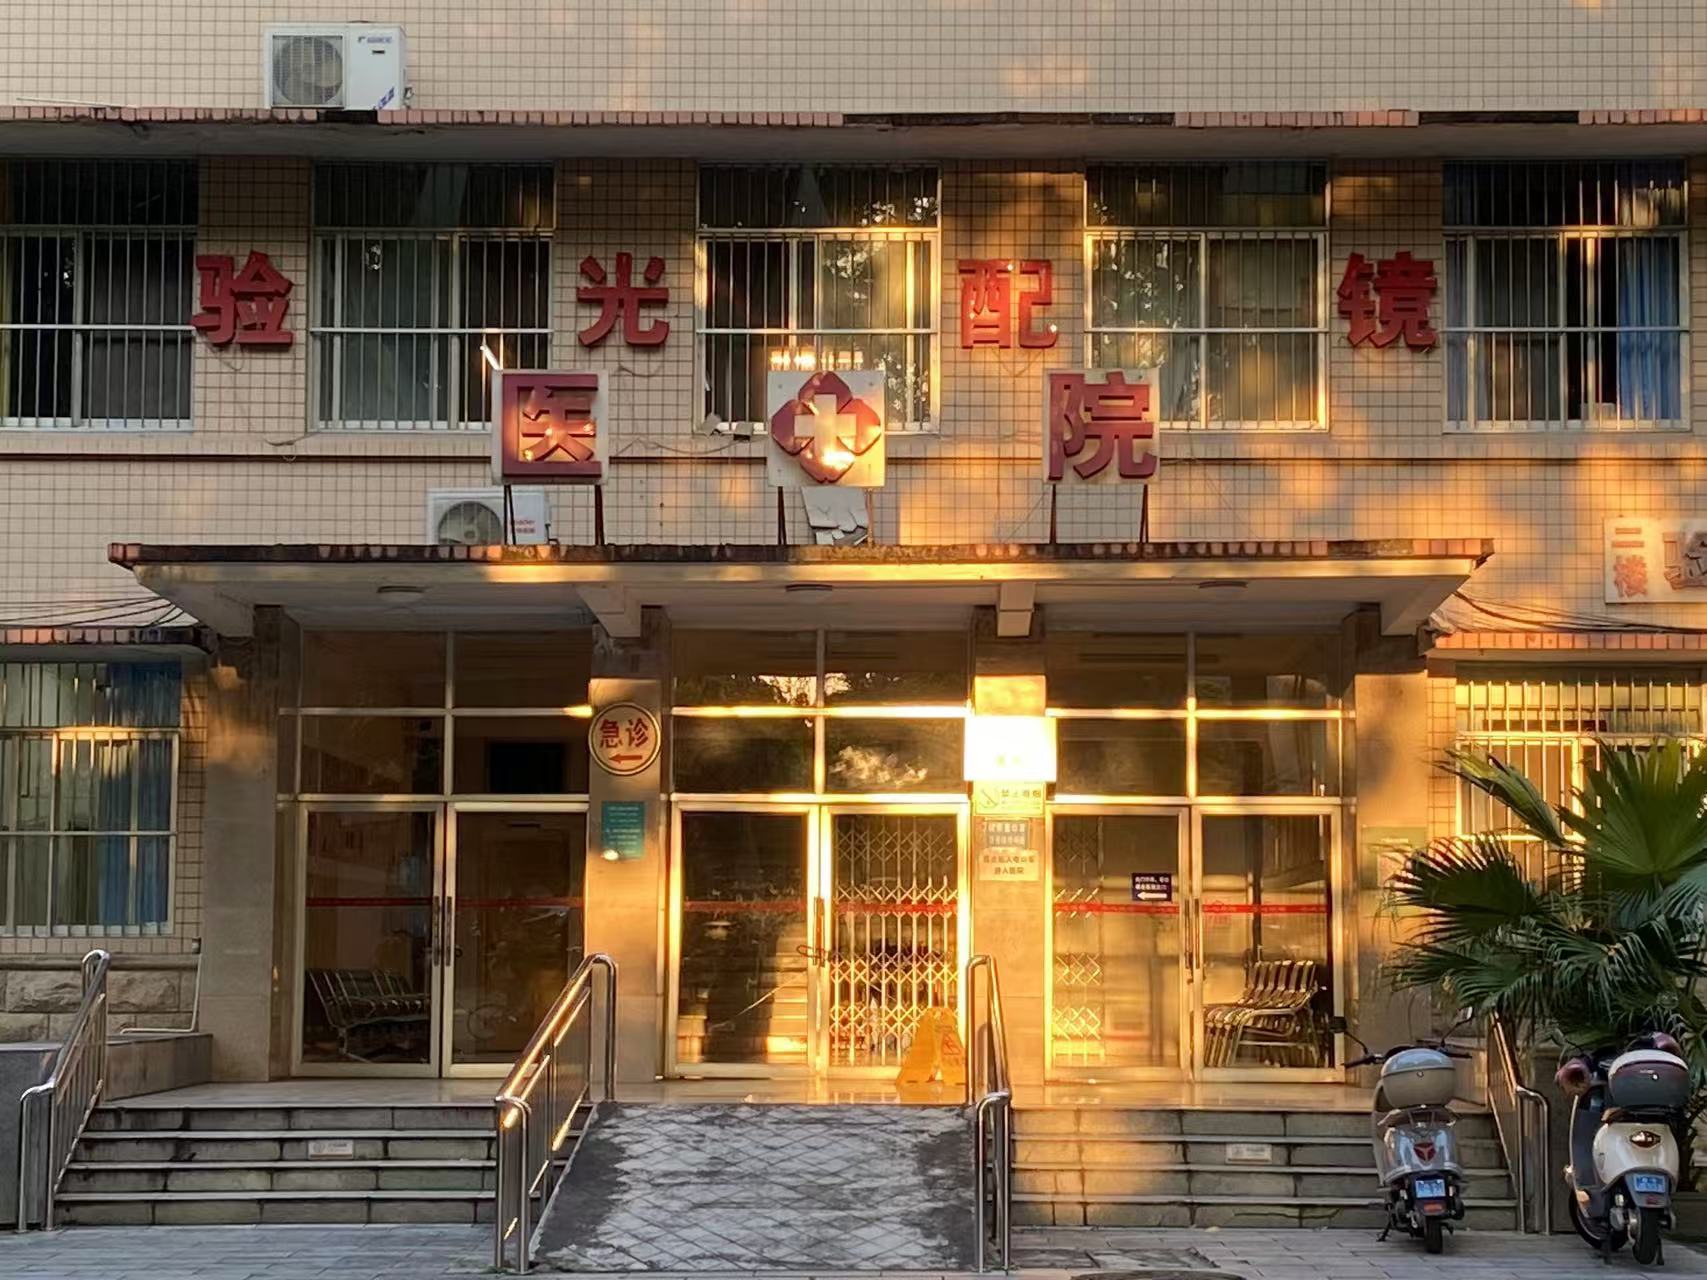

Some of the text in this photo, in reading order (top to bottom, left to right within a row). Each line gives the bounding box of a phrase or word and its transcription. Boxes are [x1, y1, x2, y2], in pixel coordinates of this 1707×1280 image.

[192, 249, 1438, 349] 验 光 配 镜
[502, 371, 1157, 480] 医 院
[599, 717, 650, 749] 急诊
